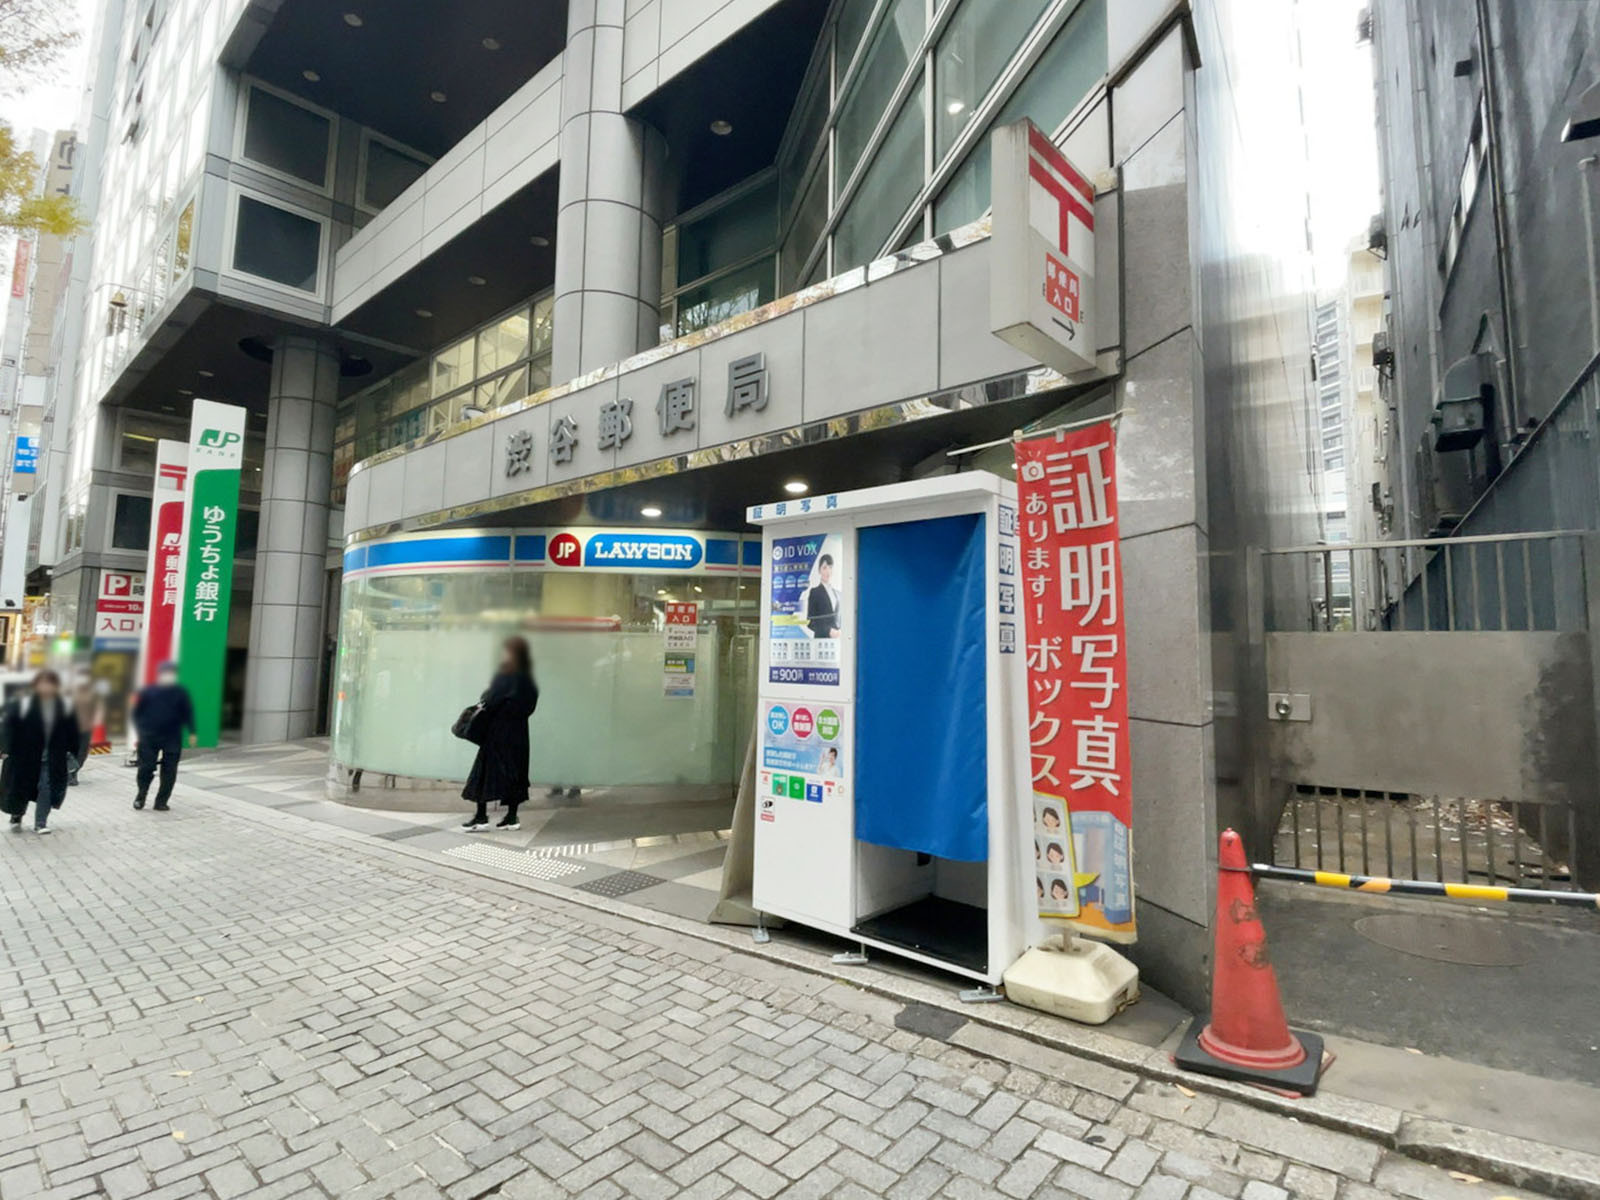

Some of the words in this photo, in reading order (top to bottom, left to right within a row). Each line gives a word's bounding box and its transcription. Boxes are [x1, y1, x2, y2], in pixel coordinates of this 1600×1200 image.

[1053, 288, 1072, 314] 入口
[506, 352, 769, 478] 渋谷郵便局
[556, 542, 577, 559] JP
[594, 542, 693, 561] LAWSON
[193, 506, 226, 622] ゆうちょ銀行
[999, 504, 1015, 654] 証明写真
[101, 617, 136, 632] 入口
[672, 615, 690, 623] 入口
[1046, 442, 1121, 797] 証明写真
